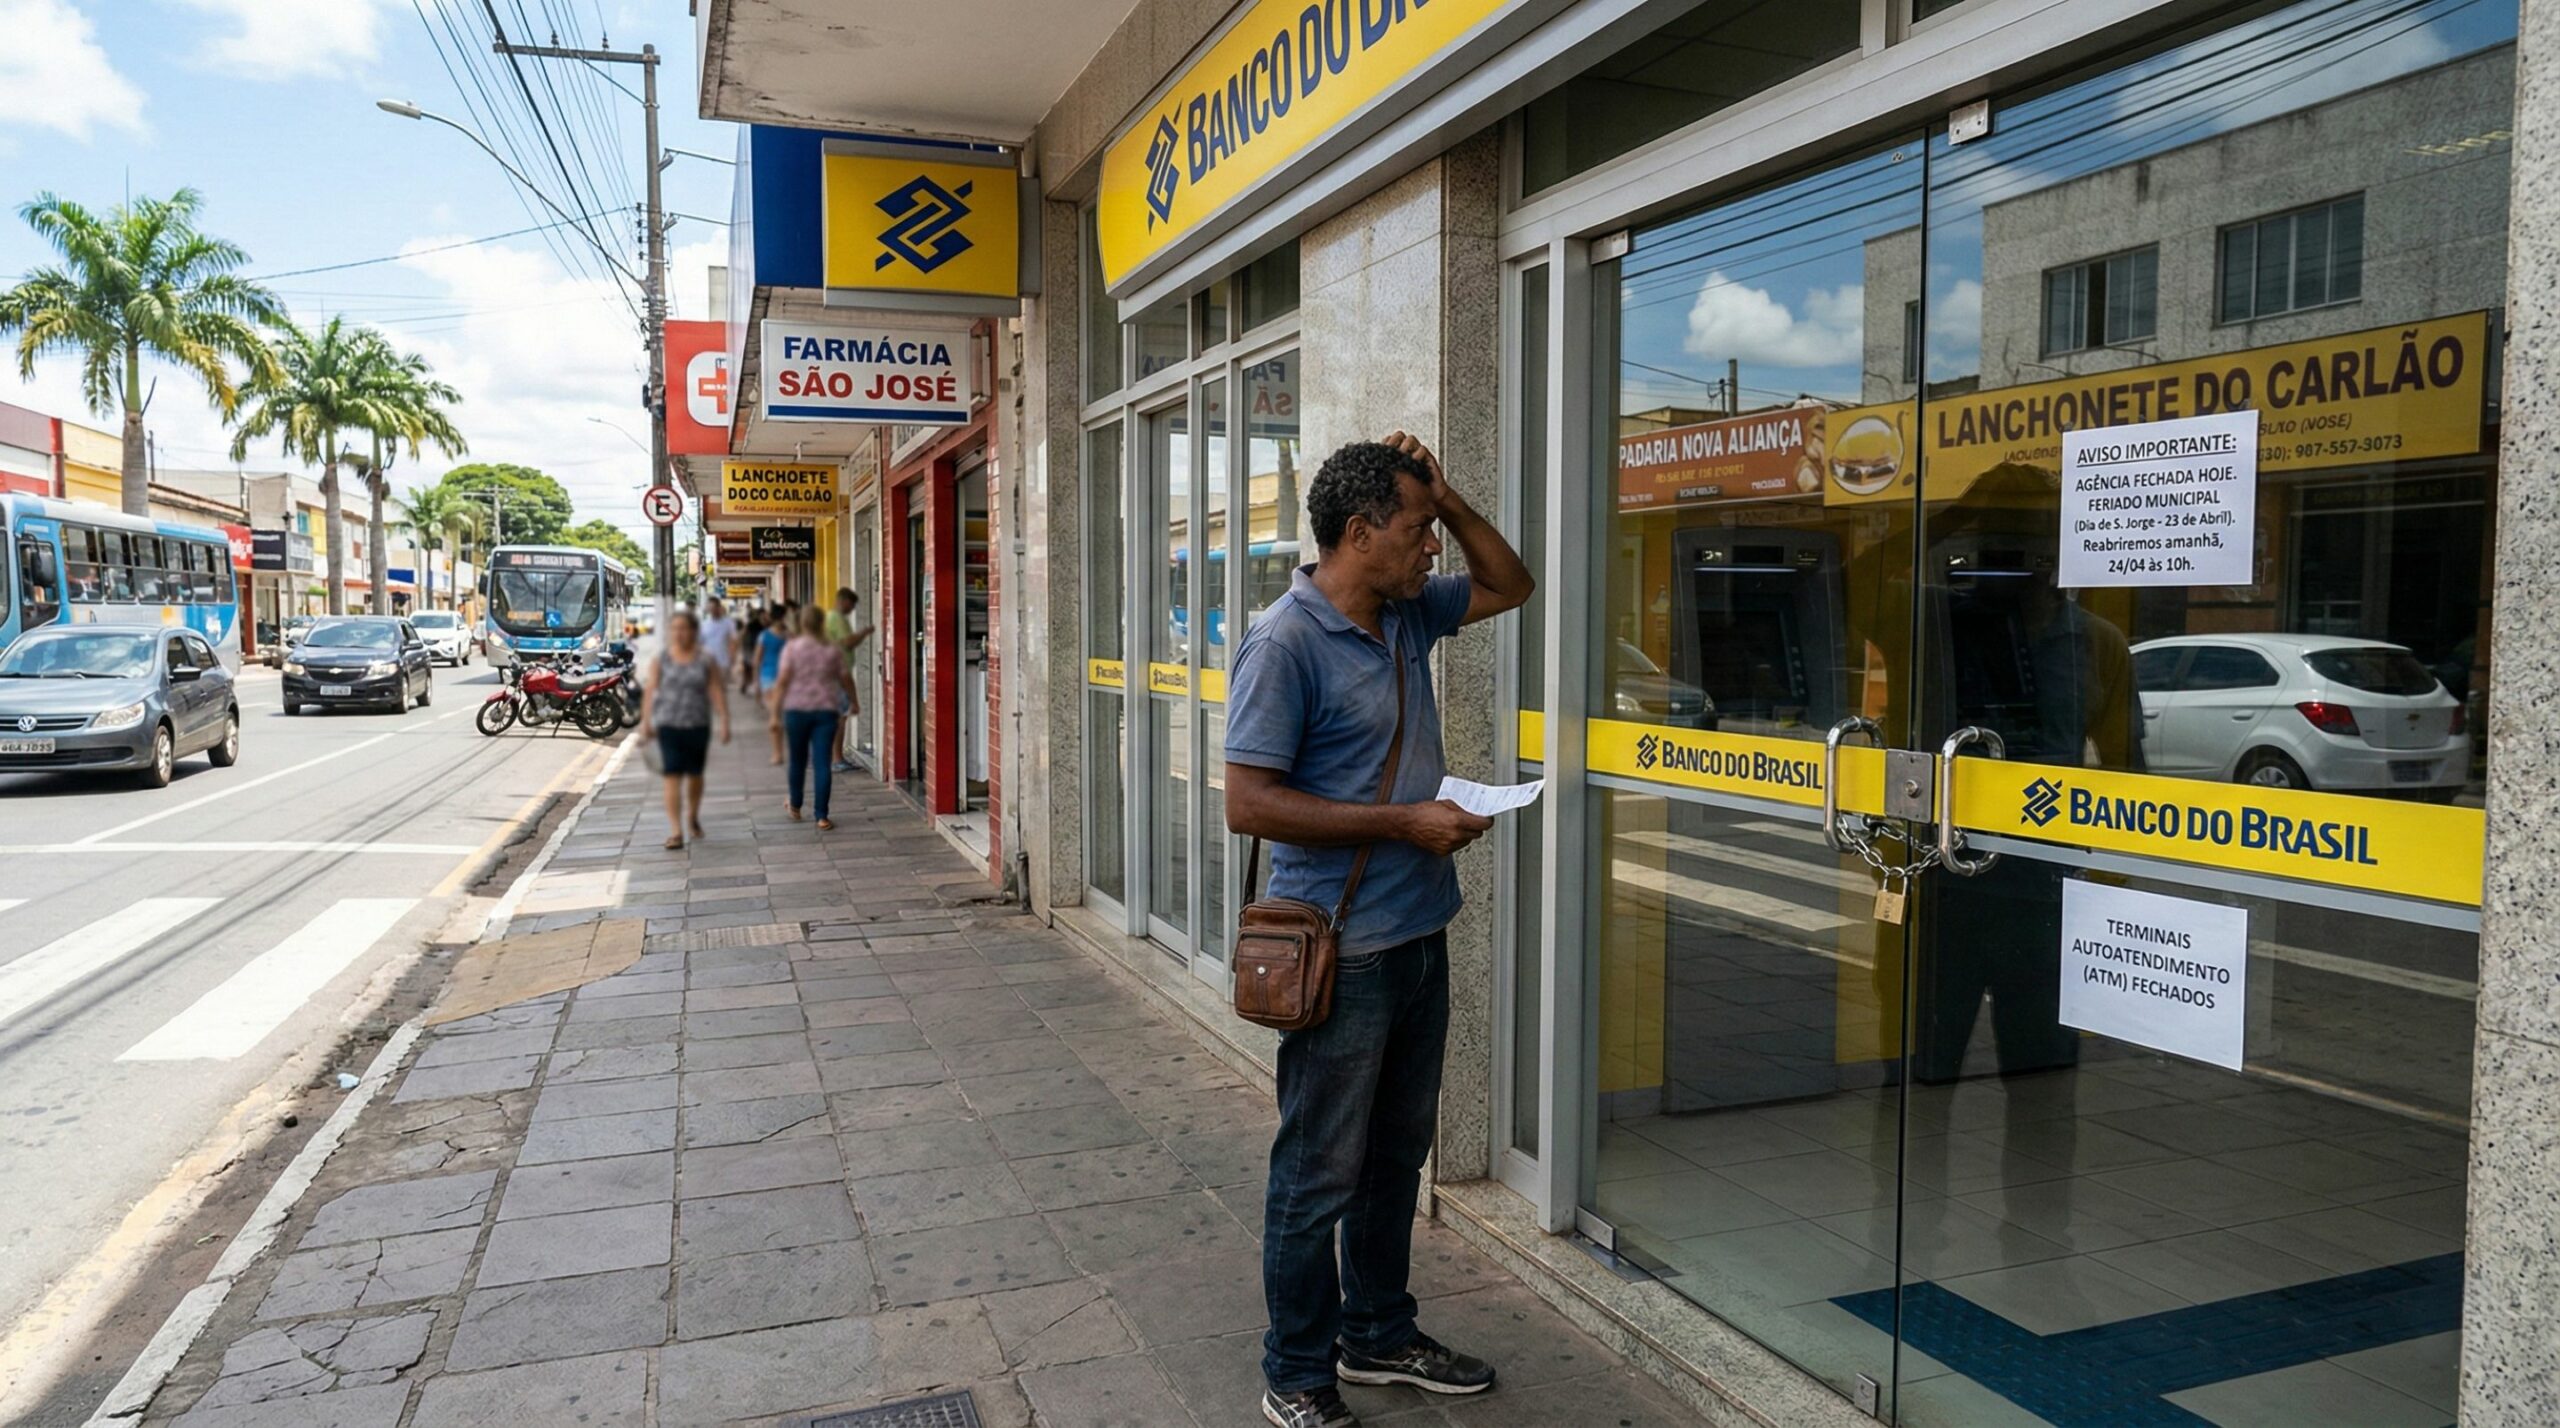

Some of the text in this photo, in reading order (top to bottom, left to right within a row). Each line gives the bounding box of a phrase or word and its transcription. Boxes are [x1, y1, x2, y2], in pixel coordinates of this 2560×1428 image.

[1188, 28, 1292, 186] BANCO
[1299, 0, 1351, 99] DO
[784, 336, 952, 366] FARMÁCIA
[779, 365, 957, 402] SÃO JOSÉ
[1938, 328, 2464, 449] LANCHONETE DO CARLÃO
[1619, 418, 1802, 469] PADARIA NOVA ALIANÇA
[2077, 445, 2122, 465] AVISO
[2125, 433, 2237, 459] IMPORTANTE:
[731, 468, 829, 484] LANCHOETE
[2075, 466, 2237, 492] AGÊNCIA FECHADA HOJE.
[2088, 490, 2220, 511] FERIADO MUNICIPAL
[2074, 519, 2096, 534] (Dia
[2098, 518, 2112, 530] de
[2113, 518, 2123, 530] S.
[2125, 516, 2155, 532] Jorge
[2164, 514, 2179, 527] 23
[2182, 512, 2197, 526] de
[2199, 510, 2236, 527] Abril).
[2083, 532, 2224, 552] Reabriremos amanhã,
[2108, 556, 2195, 575] 24/04 às 10h.
[1662, 740, 1823, 790] BANCO DO BRASIL
[2069, 787, 2378, 866] BANCO DO BRASIL
[2107, 918, 2192, 949] TERMINAIS
[2072, 938, 2230, 985] AUTOATENDIMENTO
[2083, 964, 2216, 1009] (ATM) FECHADOS
